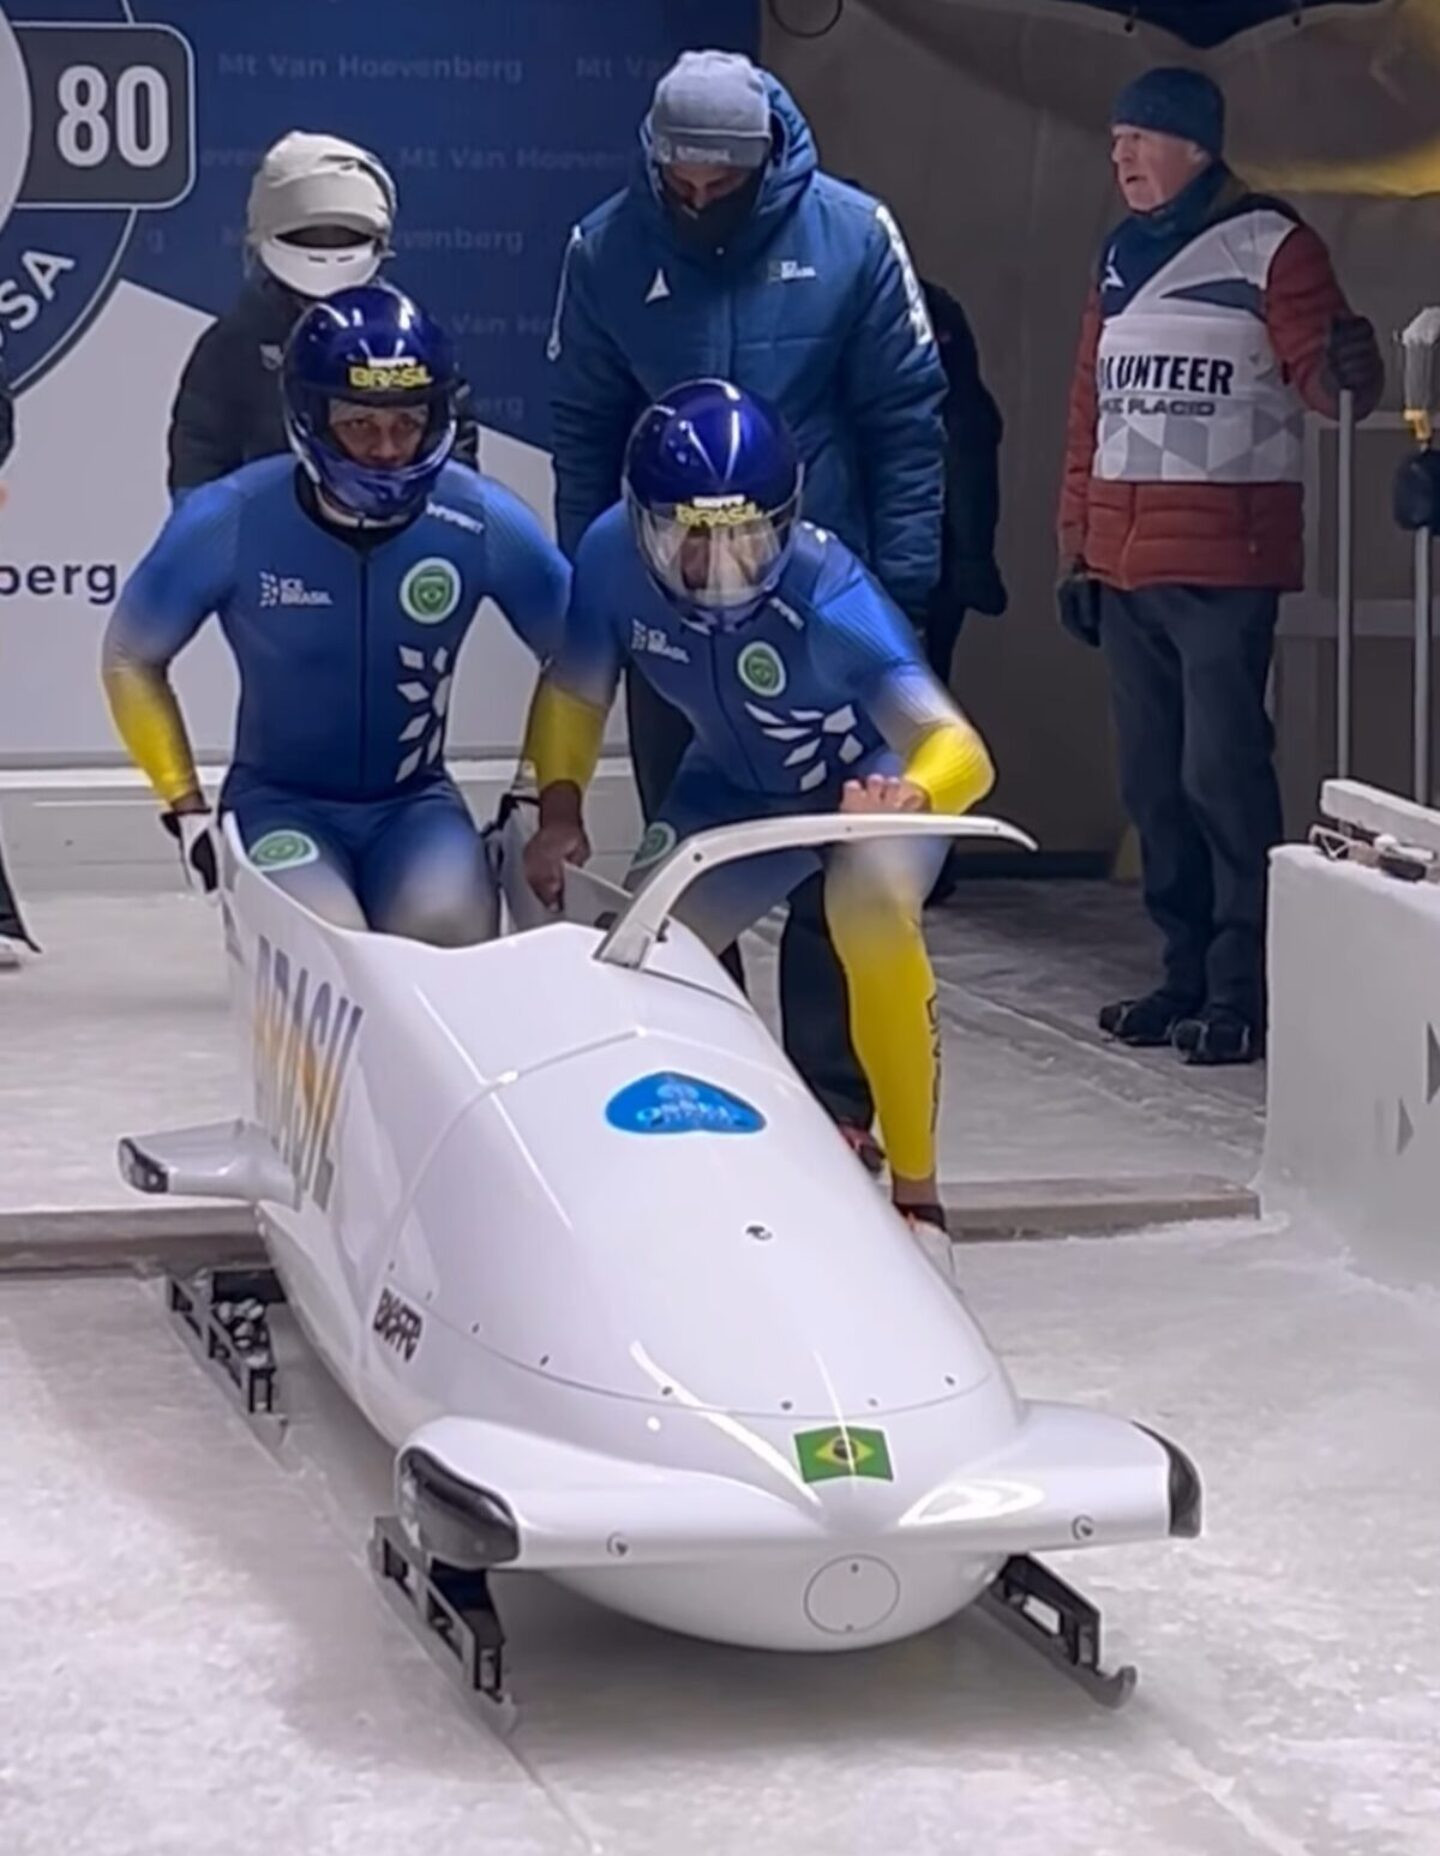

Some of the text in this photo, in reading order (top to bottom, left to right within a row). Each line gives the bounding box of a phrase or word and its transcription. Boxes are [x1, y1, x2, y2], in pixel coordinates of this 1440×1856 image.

[57, 64, 170, 168] 80
[0, 250, 76, 347] SA
[1128, 398, 1216, 417] PLACID
